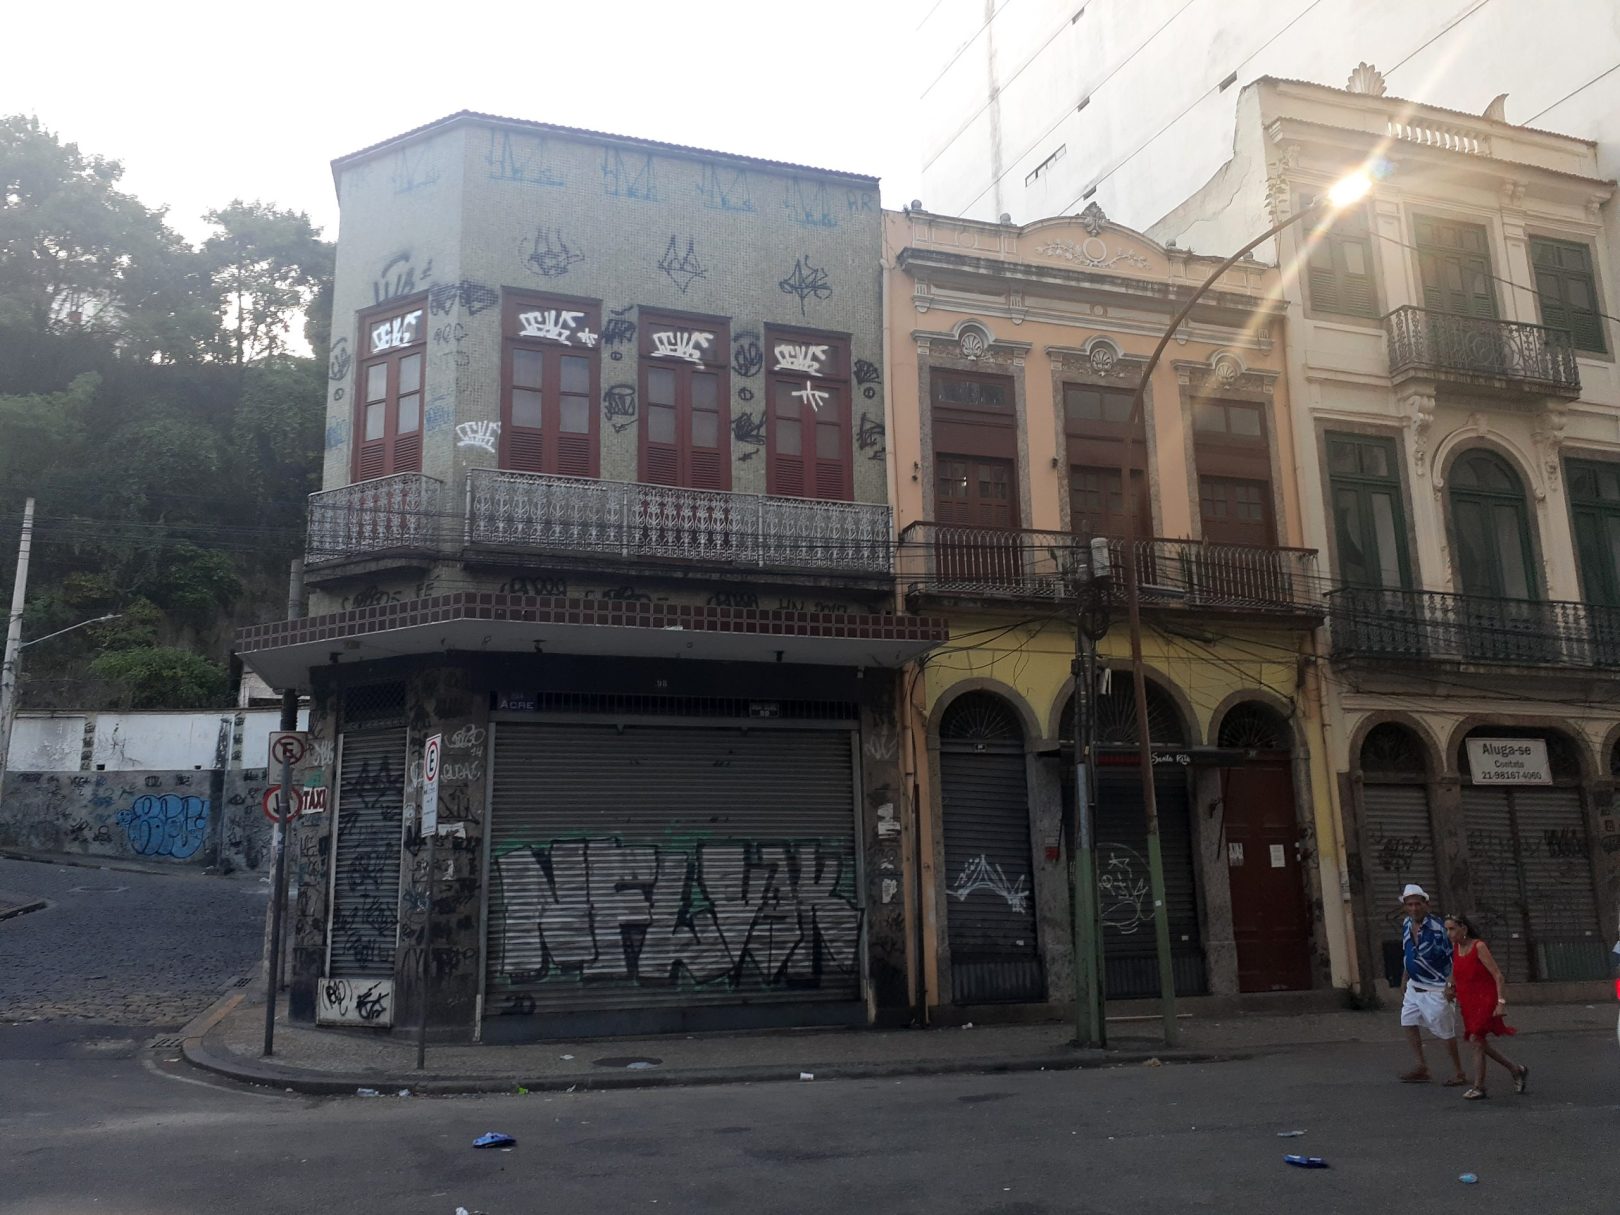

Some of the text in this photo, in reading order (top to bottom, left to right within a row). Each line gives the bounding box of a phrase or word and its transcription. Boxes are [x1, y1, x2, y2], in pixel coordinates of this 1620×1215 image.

[500, 700, 536, 709] ACRE
[1482, 743, 1532, 758] Aluga-se
[429, 749, 435, 773] E
[1152, 752, 1191, 766] Santa Rita
[1494, 760, 1525, 769] Contato
[302, 789, 327, 811] TAXI
